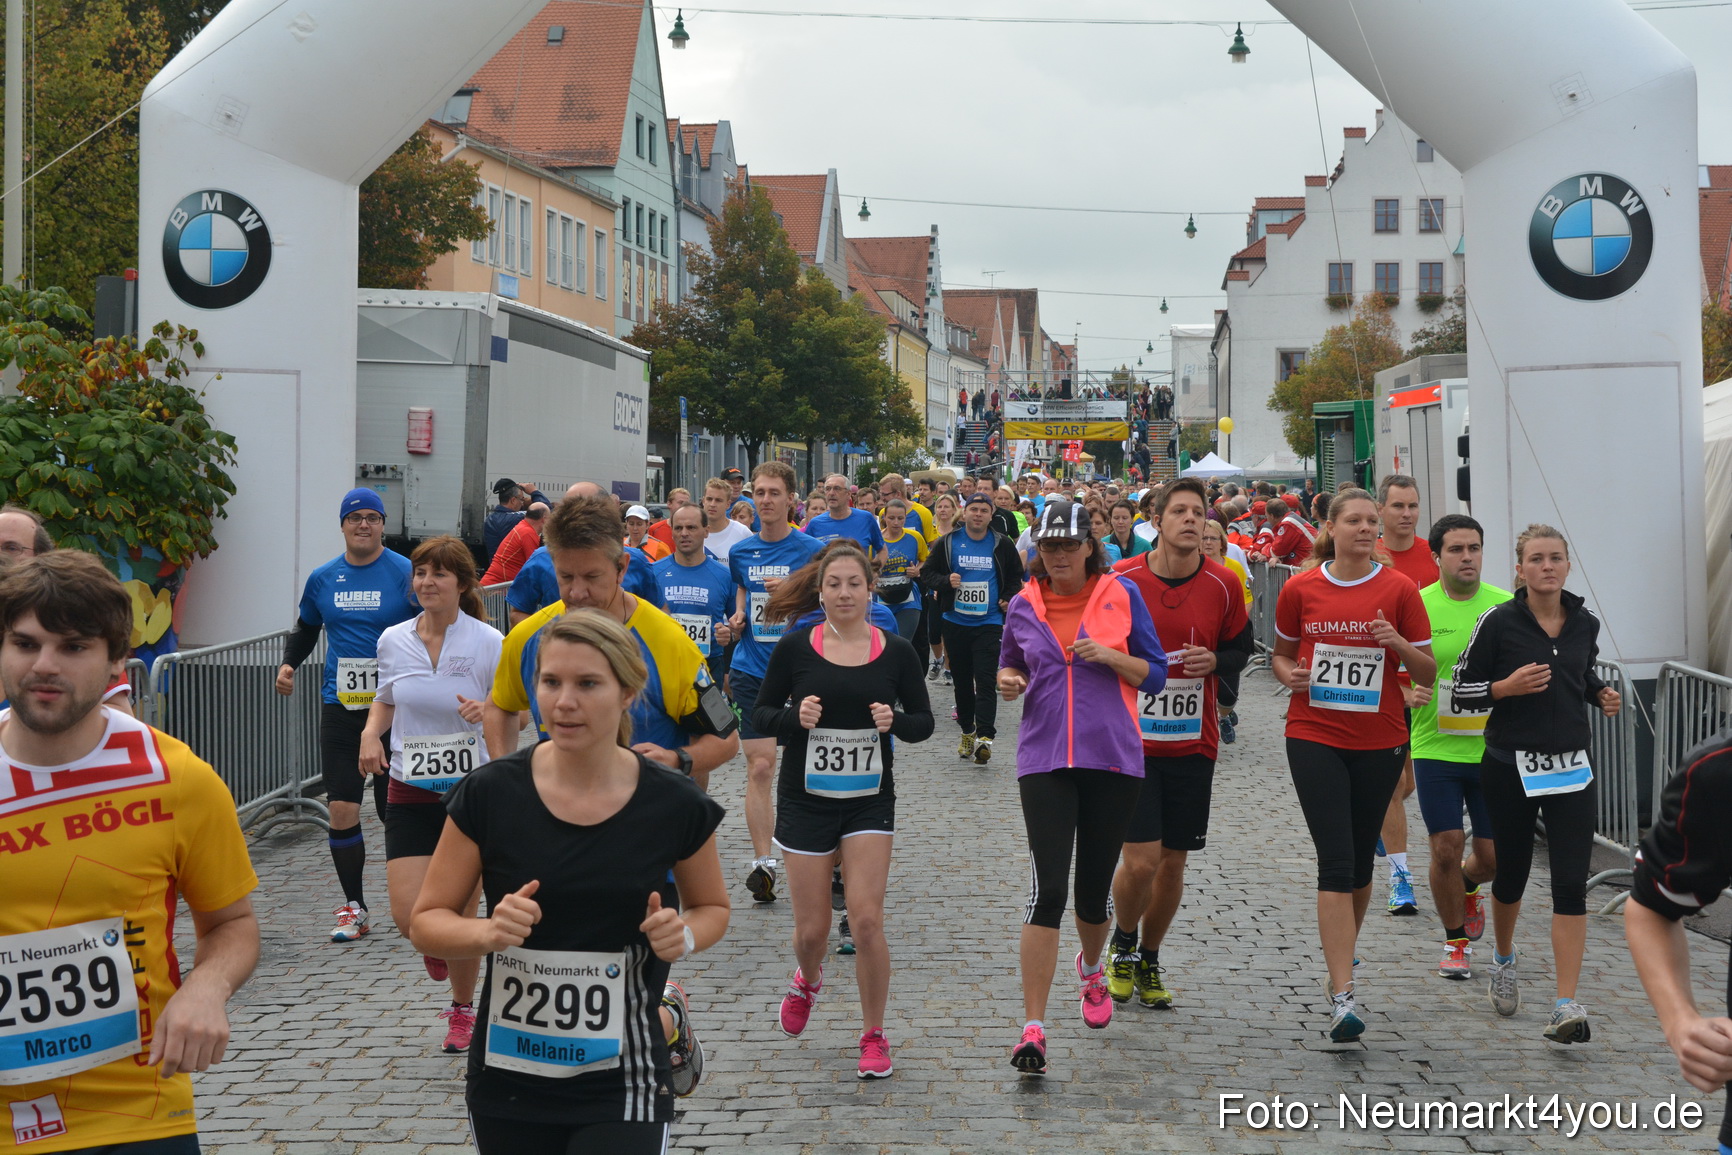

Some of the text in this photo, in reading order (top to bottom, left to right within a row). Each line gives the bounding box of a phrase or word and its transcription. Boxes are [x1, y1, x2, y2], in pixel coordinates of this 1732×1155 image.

[1539, 176, 1644, 219] BMW
[170, 192, 263, 232] BMW
[1044, 425, 1088, 436] START
[958, 555, 993, 565] HUBER
[748, 565, 790, 576] HUBER
[334, 590, 381, 602] HUBER
[664, 585, 709, 598] HUBER
[957, 589, 986, 603] 2860
[758, 627, 784, 635] Sebasti
[1314, 649, 1372, 660] PARTL Neumarkt
[1316, 659, 1378, 687] 2167
[1143, 693, 1198, 717] 2166
[1323, 689, 1365, 703] Christina
[1151, 722, 1187, 732] Andreas
[403, 738, 466, 750] PARTL Neumarkt
[809, 734, 870, 744] PARTL Neumarkt
[410, 748, 473, 777] 2530
[814, 745, 875, 772] 3317
[1523, 750, 1583, 774] 3312
[429, 780, 454, 791] Julia
[0, 798, 174, 855] AX BÖGL
[20, 937, 99, 963] Neumarkt
[495, 953, 600, 977] PARTL Neumarkt
[501, 976, 611, 1032] 2299
[24, 1033, 92, 1061] Marco
[516, 1036, 586, 1063] Melanie
